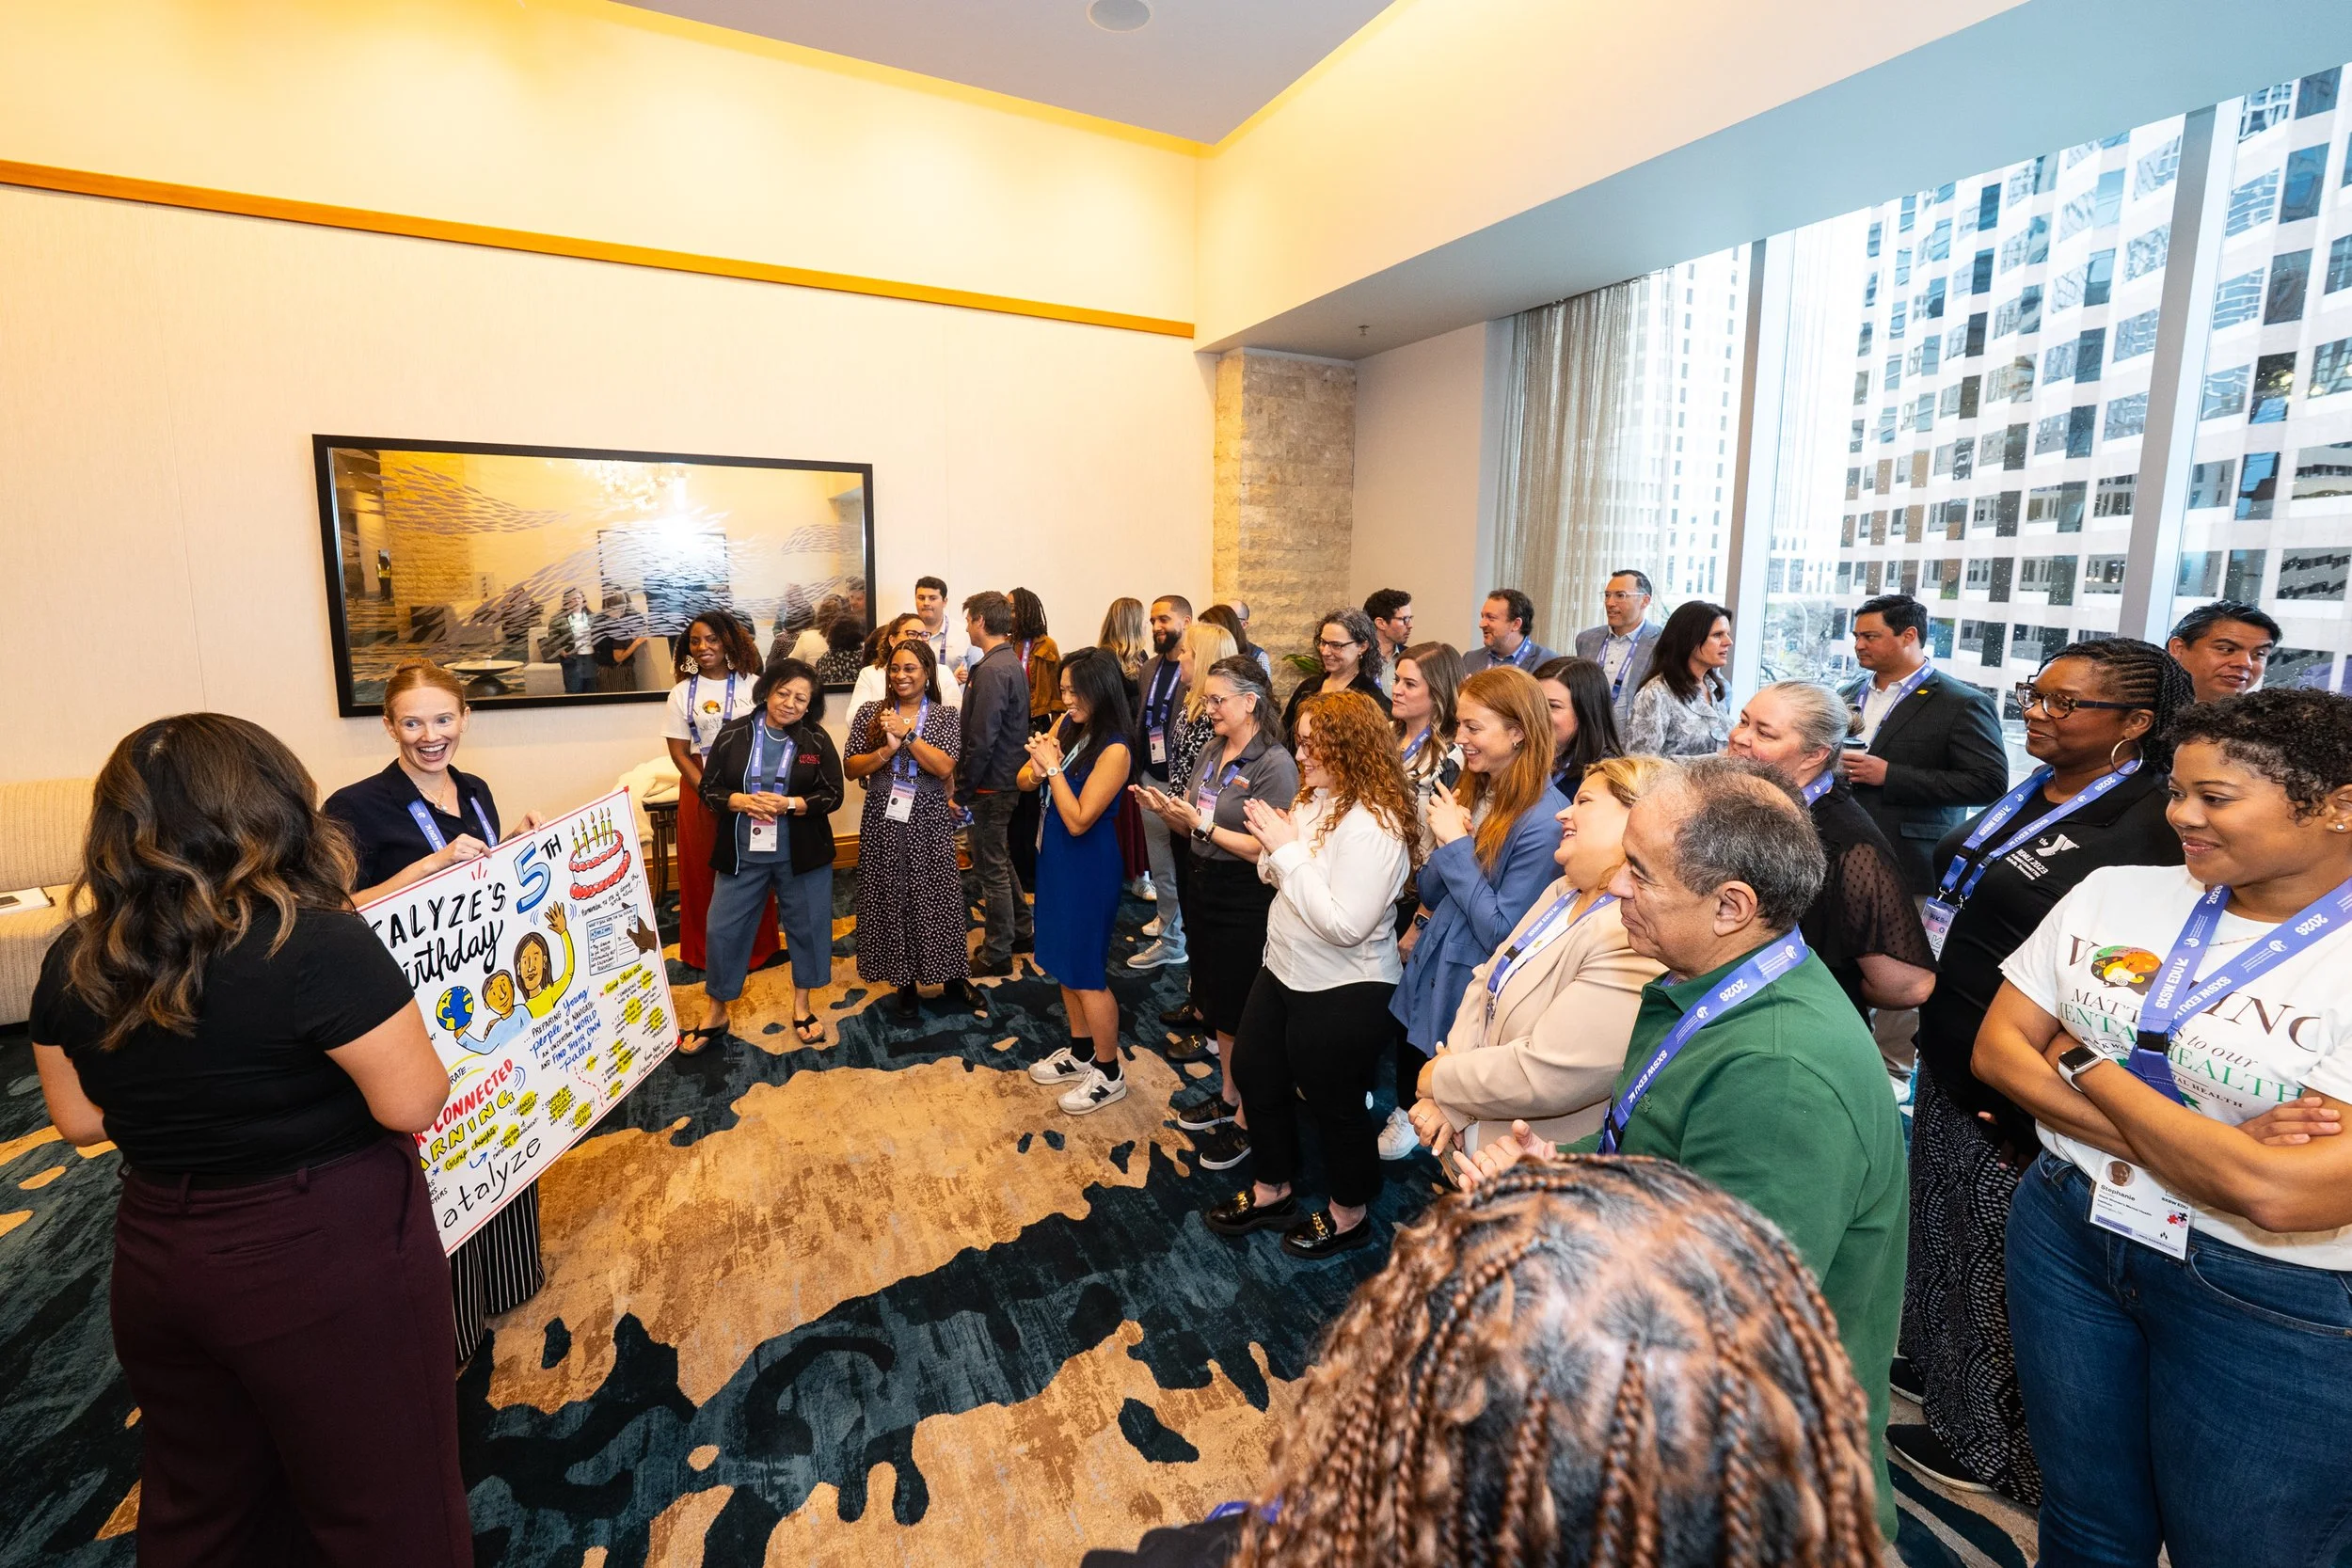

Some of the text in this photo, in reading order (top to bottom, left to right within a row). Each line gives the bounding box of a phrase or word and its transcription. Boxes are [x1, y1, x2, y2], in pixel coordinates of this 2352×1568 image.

[2094, 777, 2116, 792] 2026
[427, 828, 438, 842] EDU
[1979, 809, 2007, 837] SXSW EDU
[2014, 818, 2049, 843] SXSW EDU
[2031, 859, 2049, 875] 2023
[2206, 884, 2223, 905] 2026
[2295, 913, 2328, 935] 2026
[403, 920, 504, 989] irthday
[1719, 978, 1748, 1002] 2026
[2154, 961, 2186, 1009] SXSW EDU
[2178, 975, 2233, 1016] SXSW EDU
[532, 1010, 562, 1037] PREPARING
[571, 1001, 595, 1022] NAVIGATE
[2059, 1002, 2137, 1043] ENTA
[540, 1018, 601, 1071] AND FIND THEIR OWN
[542, 1009, 596, 1058] AN UNCERTAIN WORLD
[2187, 1034, 2207, 1051] to
[2211, 1047, 2258, 1069] our
[1633, 1050, 1668, 1097] SXSW EDU
[2192, 1083, 2244, 1109] HEALTH
[421, 1090, 515, 1170] RNING
[445, 1148, 469, 1171] Group
[444, 1137, 541, 1228] atalyze
[2101, 1184, 2136, 1201] Stephanie
[2162, 1196, 2177, 1206] SXSW
